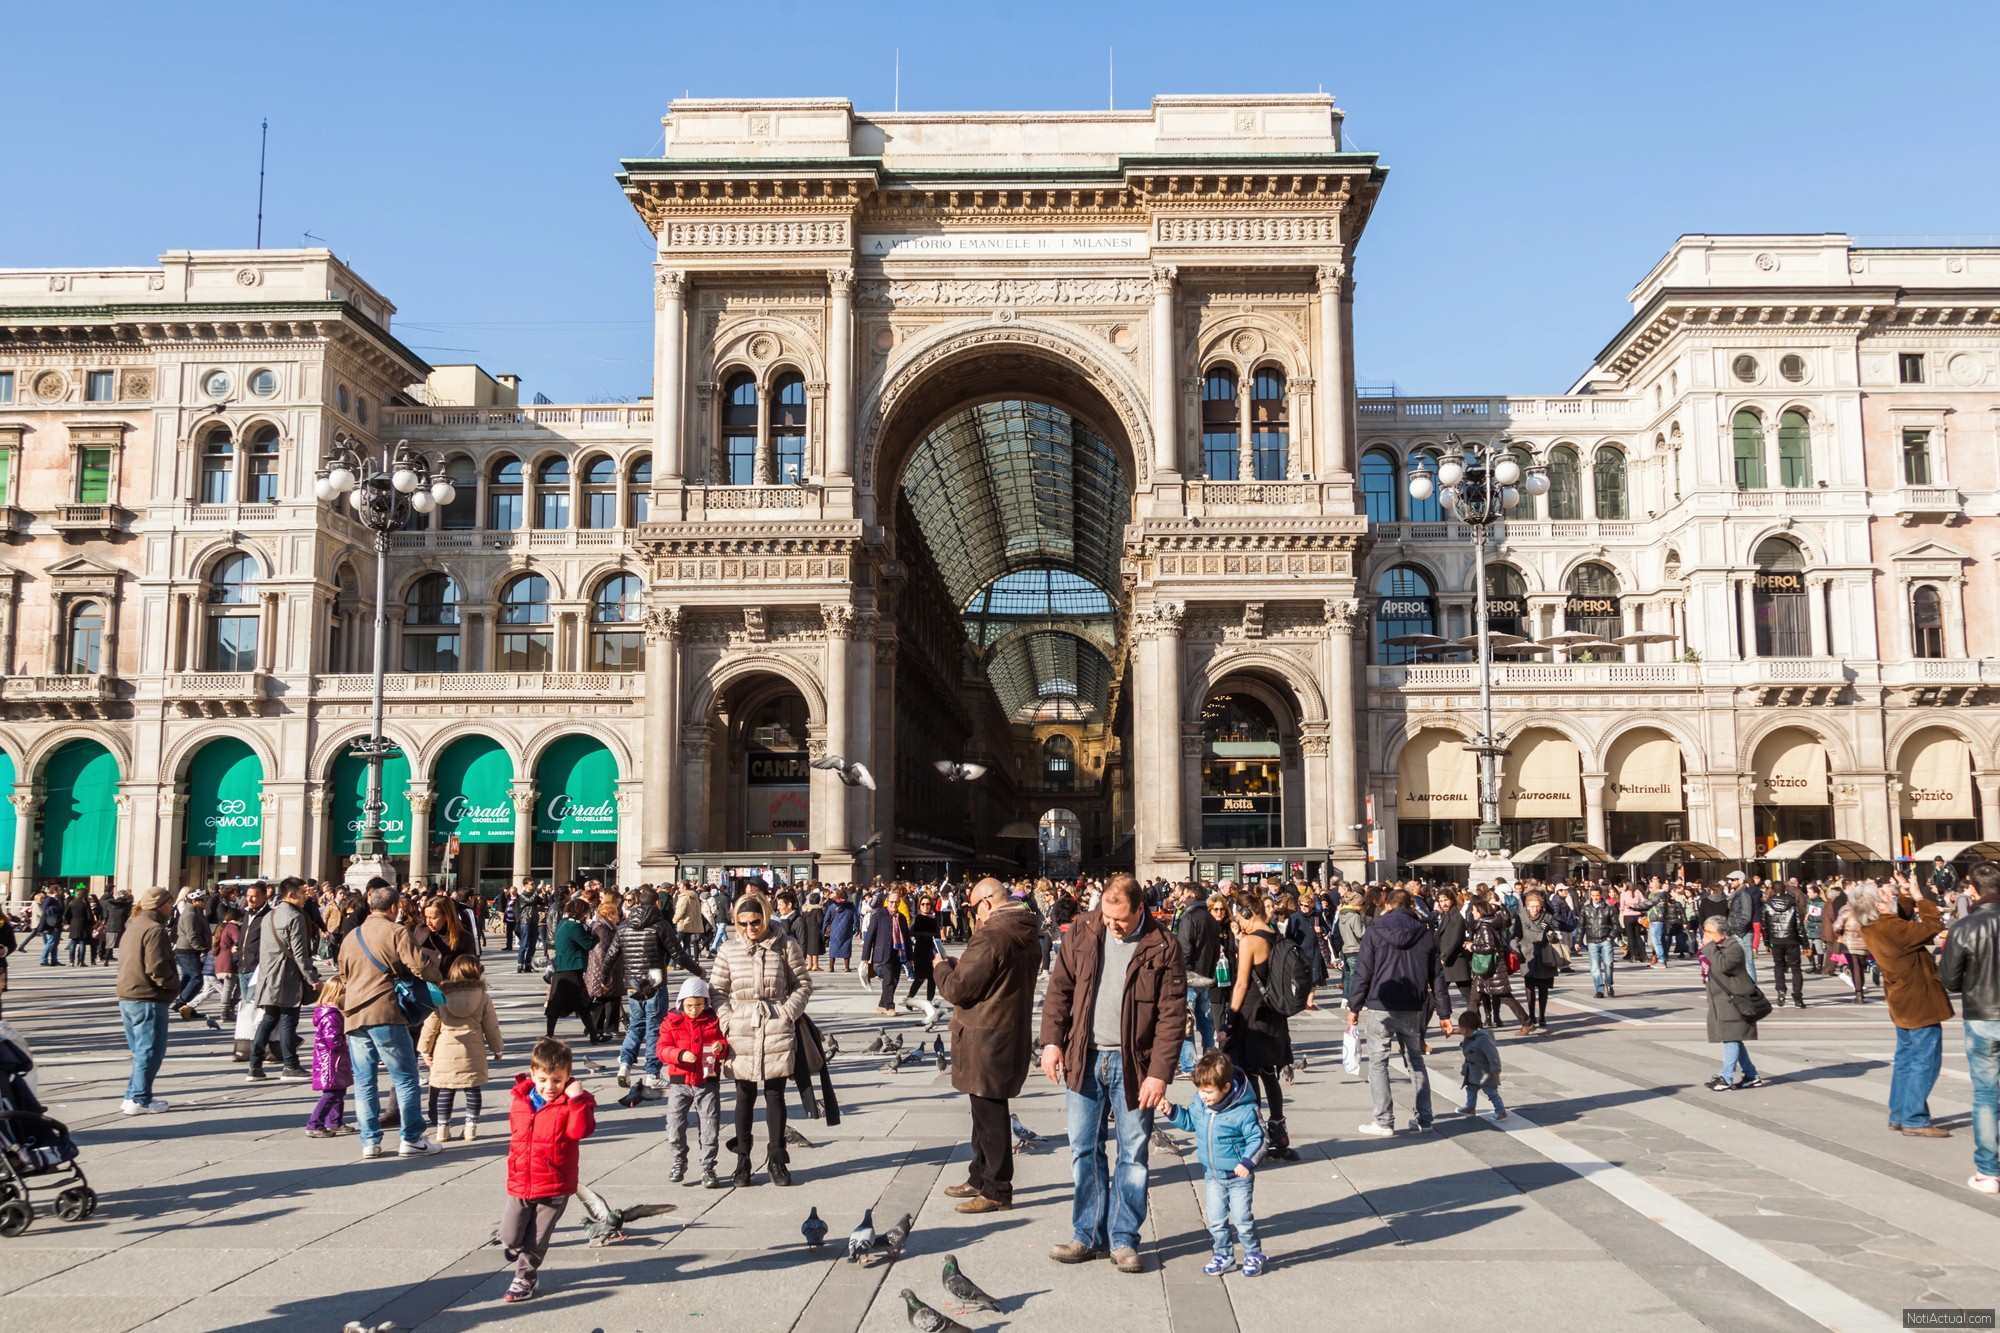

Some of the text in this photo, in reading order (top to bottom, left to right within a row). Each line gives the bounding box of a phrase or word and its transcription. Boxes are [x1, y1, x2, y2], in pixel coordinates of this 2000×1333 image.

[875, 240, 883, 249] A
[892, 240, 952, 249] VITTORIO
[960, 239, 1031, 249] EMANUELE
[1073, 238, 1132, 248] MILANESI
[1381, 600, 1427, 614] APEROL
[1567, 598, 1614, 612] APEROL
[1619, 784, 1671, 793] Feltrinelli
[1417, 793, 1468, 801] AUTOGRILL
[1520, 792, 1571, 800] AUTOGRILL
[444, 795, 511, 823] Currado
[547, 794, 614, 821] Currado
[1223, 799, 1254, 810] Motta
[204, 816, 259, 827] GRIMOLDI
[347, 820, 404, 831] GROLDI
